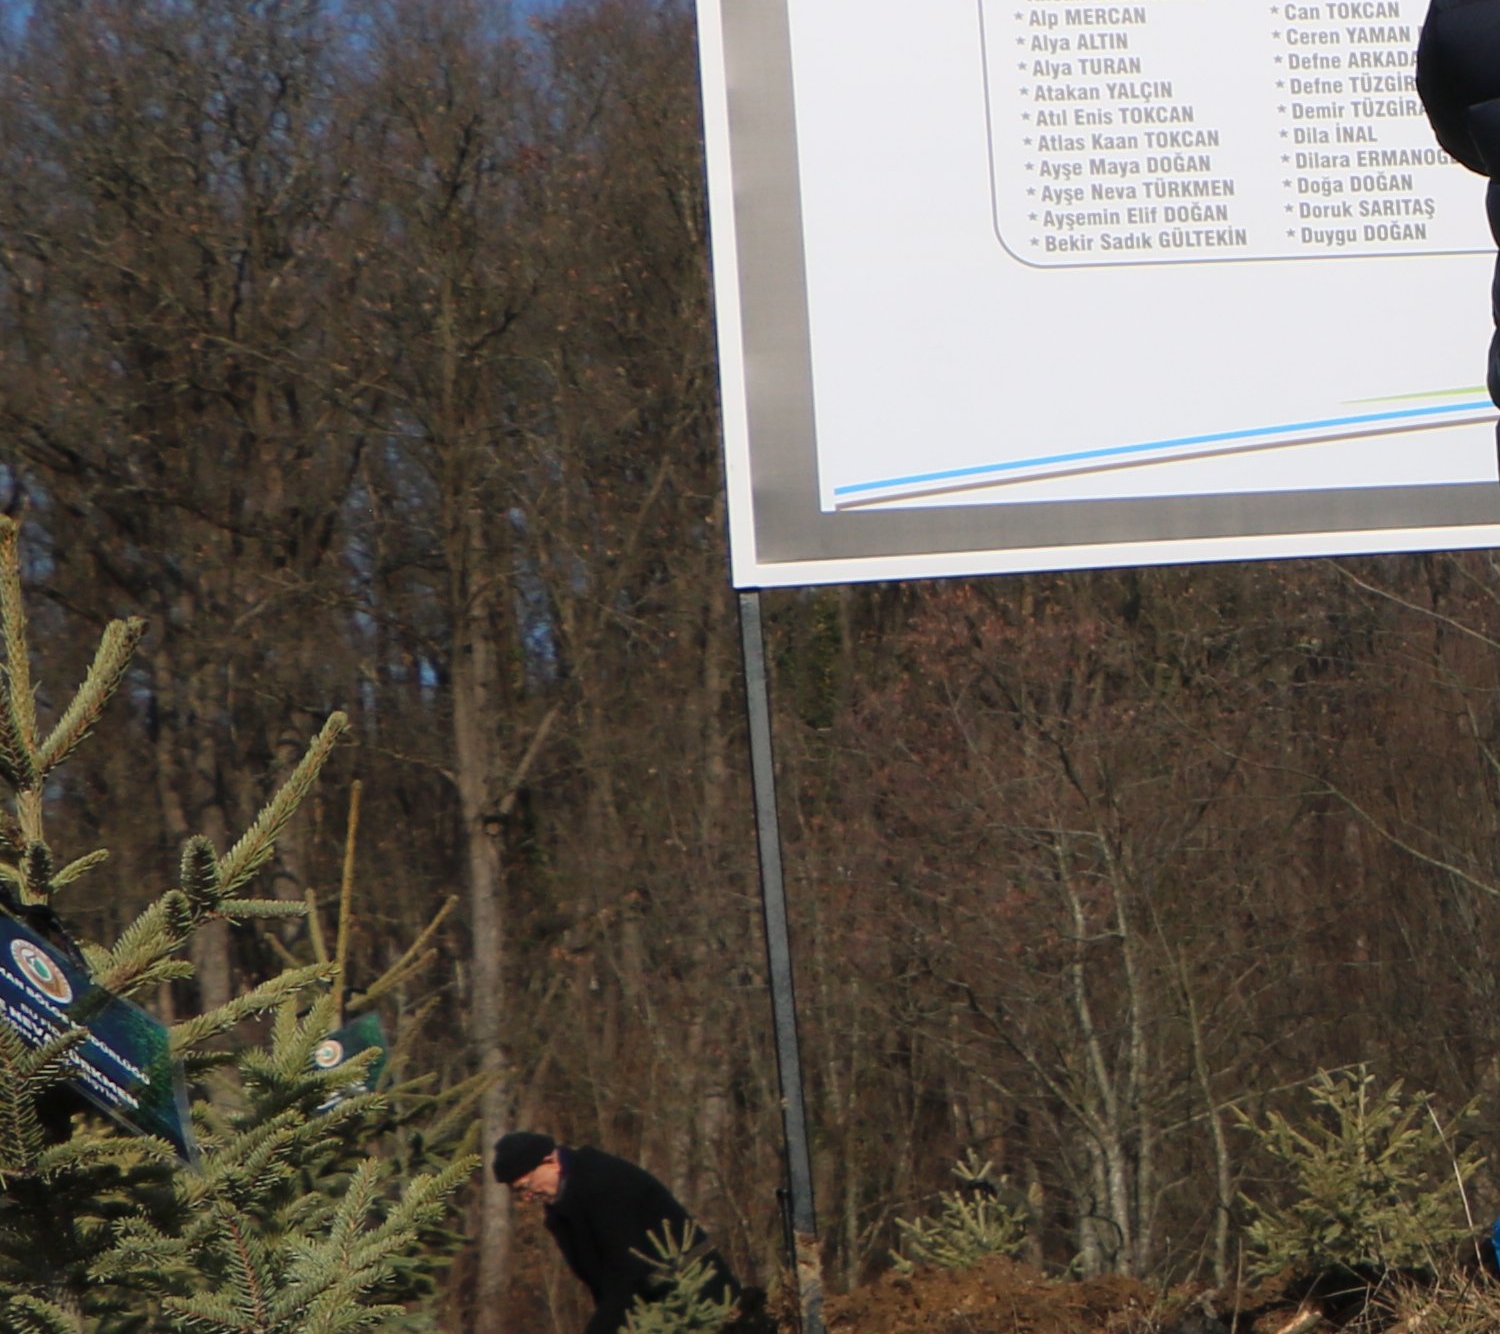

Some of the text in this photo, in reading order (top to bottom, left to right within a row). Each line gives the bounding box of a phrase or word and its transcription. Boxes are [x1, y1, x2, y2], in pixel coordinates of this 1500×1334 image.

[1029, 7, 1146, 29] Alp MERCAN
[1285, 2, 1400, 20] Can TOKCAN
[1031, 32, 1128, 54] Alya ALTIN
[1286, 28, 1340, 45] Ceren
[1346, 26, 1410, 43] YAMAN
[1033, 57, 1141, 79] Alya TURAN
[1289, 53, 1341, 69] Defne
[1035, 82, 1172, 103] Atakan YALÇIN
[1290, 73, 1417, 94] Defne TÜZGİR
[1036, 106, 1193, 126] Atıl Enis TOKCAN
[1292, 103, 1344, 119] Demir
[1038, 130, 1219, 152] Atlas Kaan TOKCAN
[1294, 123, 1377, 144] Dila İNAL
[1040, 153, 1211, 180] Ayşe Maya DOĞAN
[1296, 152, 1350, 169] Dilara
[1041, 178, 1234, 205] Ayşe Neva TÜRKMEN
[1297, 171, 1412, 196] Doğa DOĞAN
[1043, 202, 1228, 230] Ayşemin Elif DOĞAN
[1299, 198, 1435, 219] Doruk SARITAŞ
[1045, 226, 1247, 252] Bekir Sadık GÜLTEKİN
[1301, 221, 1427, 246] Duygu DOĞAN
